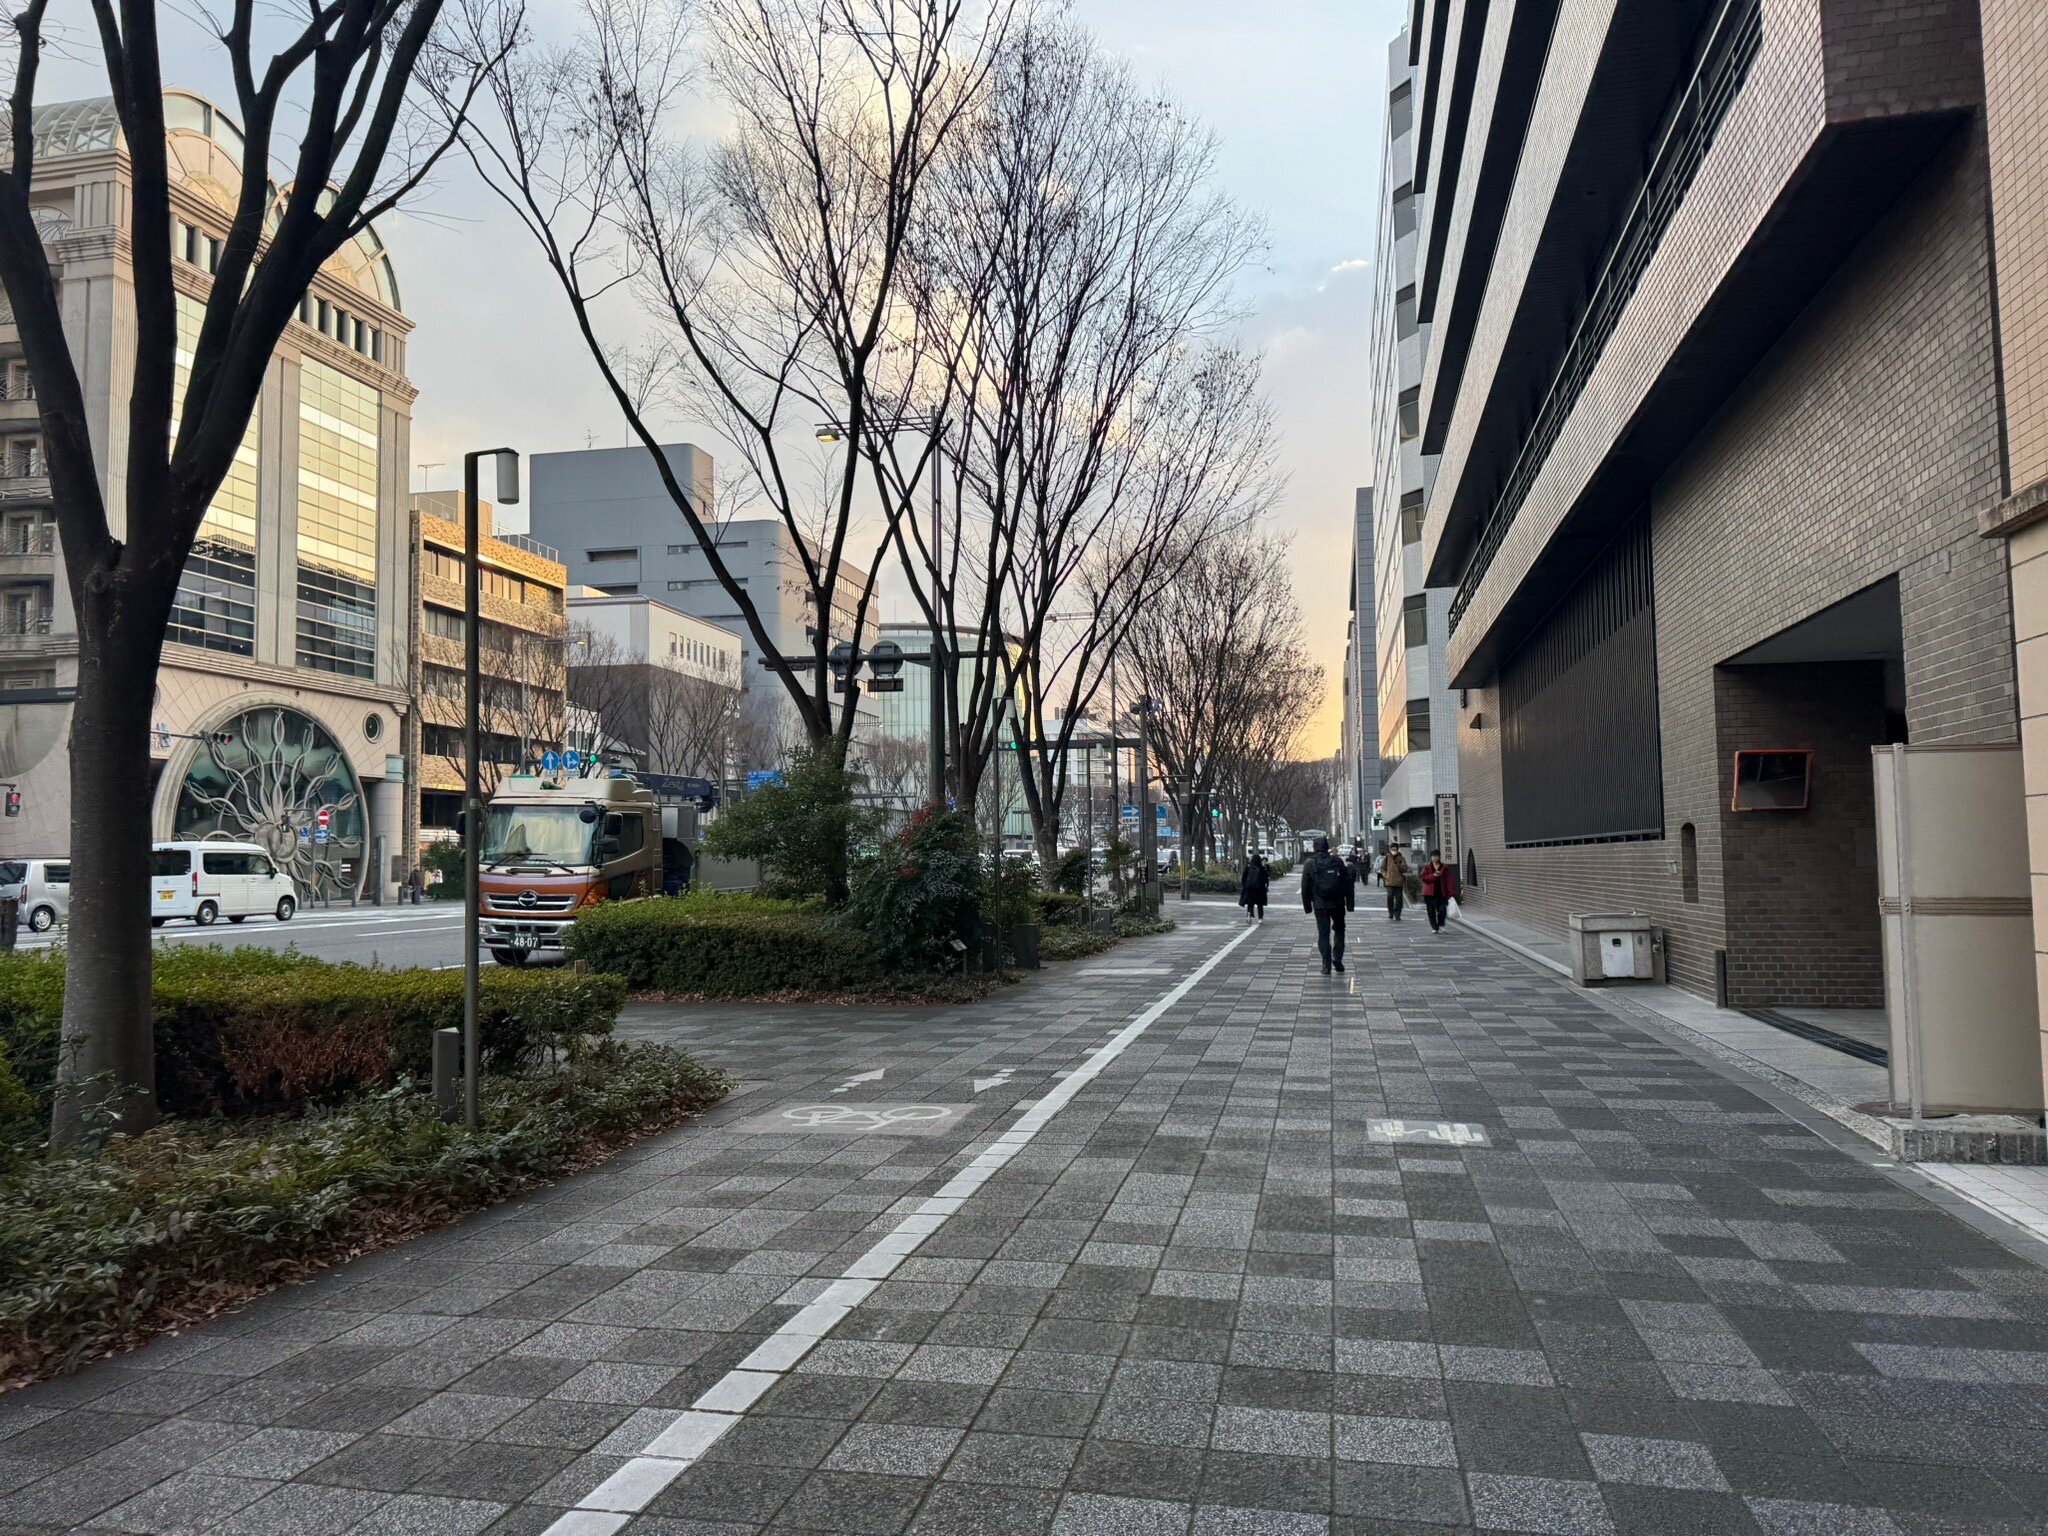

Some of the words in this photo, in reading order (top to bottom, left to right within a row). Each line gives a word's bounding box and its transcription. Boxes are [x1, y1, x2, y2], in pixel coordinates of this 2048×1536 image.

[1442, 801, 1453, 861] 京都市市税事務所
